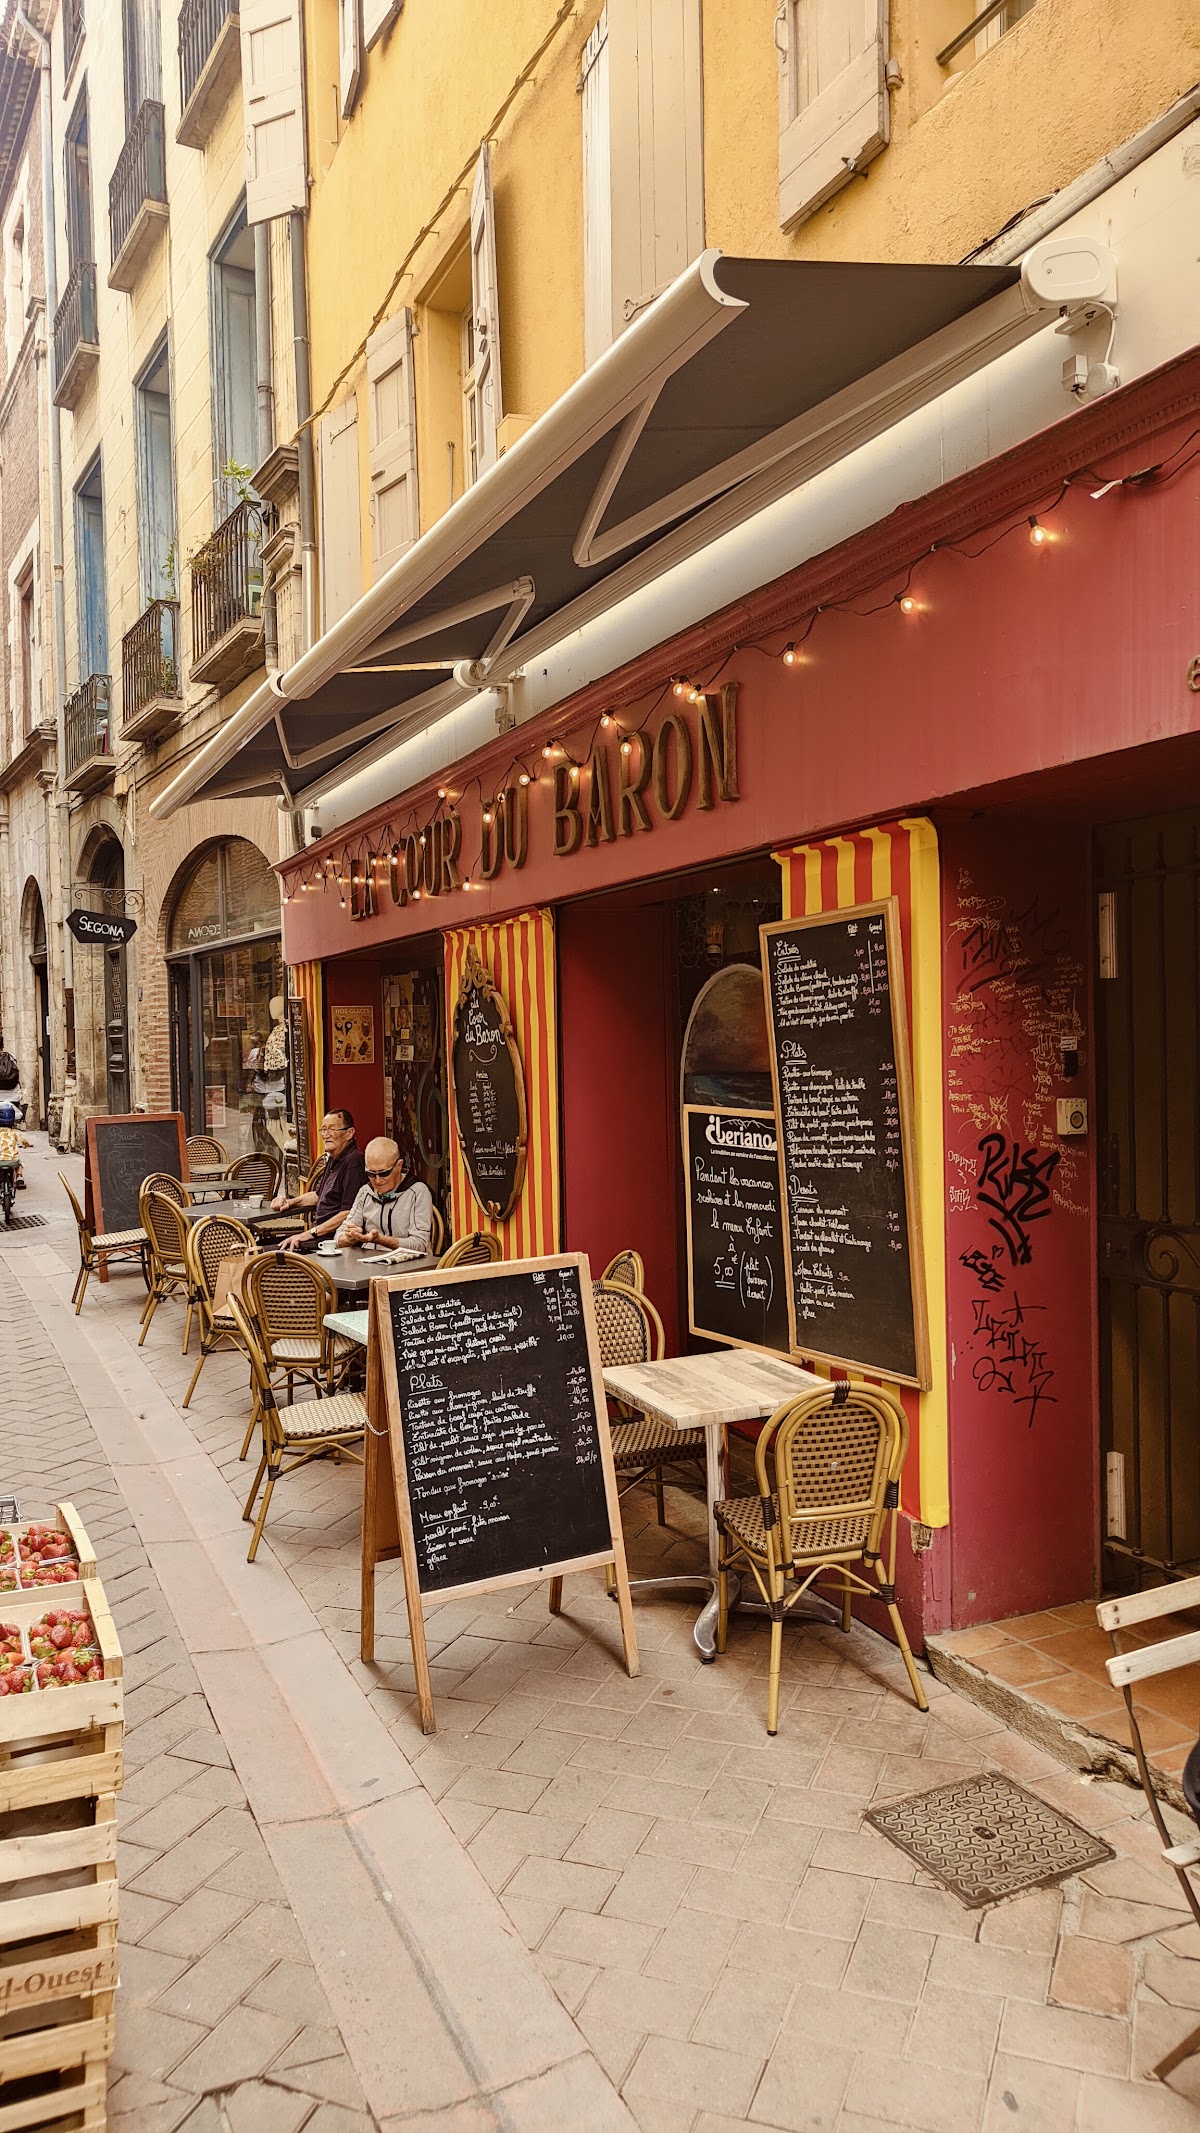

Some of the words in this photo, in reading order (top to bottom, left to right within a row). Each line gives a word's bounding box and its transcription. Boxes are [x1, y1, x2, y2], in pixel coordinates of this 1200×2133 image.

[349, 848, 380, 922] LA
[389, 812, 463, 907] COUR
[478, 781, 529, 880] DU
[551, 680, 742, 857] BARON
[78, 915, 125, 938] SEGONA
[475, 1024, 506, 1046] Baron
[694, 1156, 728, 1184] Pendant
[729, 1166, 740, 1186] les
[740, 1178, 775, 1191] vacances
[723, 1189, 732, 1206] et
[710, 1208, 720, 1229] le
[721, 1221, 745, 1233] menu
[398, 1304, 425, 1316] Salade
[424, 1304, 434, 1312] de
[400, 1315, 426, 1327] Salade
[427, 1312, 436, 1320] de
[458, 1304, 482, 1315] chaud
[400, 1325, 427, 1336] Salade
[428, 1321, 449, 1332] Baron
[426, 1335, 435, 1343] de
[496, 1318, 519, 1332] truffe
[402, 1348, 417, 1360] Foie
[419, 1348, 433, 1364] gras
[409, 1372, 444, 1393] Plats
[506, 1388, 516, 1398] de
[514, 1383, 537, 1398] truffe
[436, 1415, 448, 1426] de
[447, 1423, 460, 1434] de
[502, 1410, 532, 1423] salade
[428, 1440, 438, 1450] de
[454, 1447, 463, 1457] de
[436, 1467, 448, 1476] du
[413, 1486, 442, 1500] Fondue
[419, 1510, 443, 1524] Menu
[421, 1524, 450, 1545] poulet
[426, 1553, 449, 1571] glace
